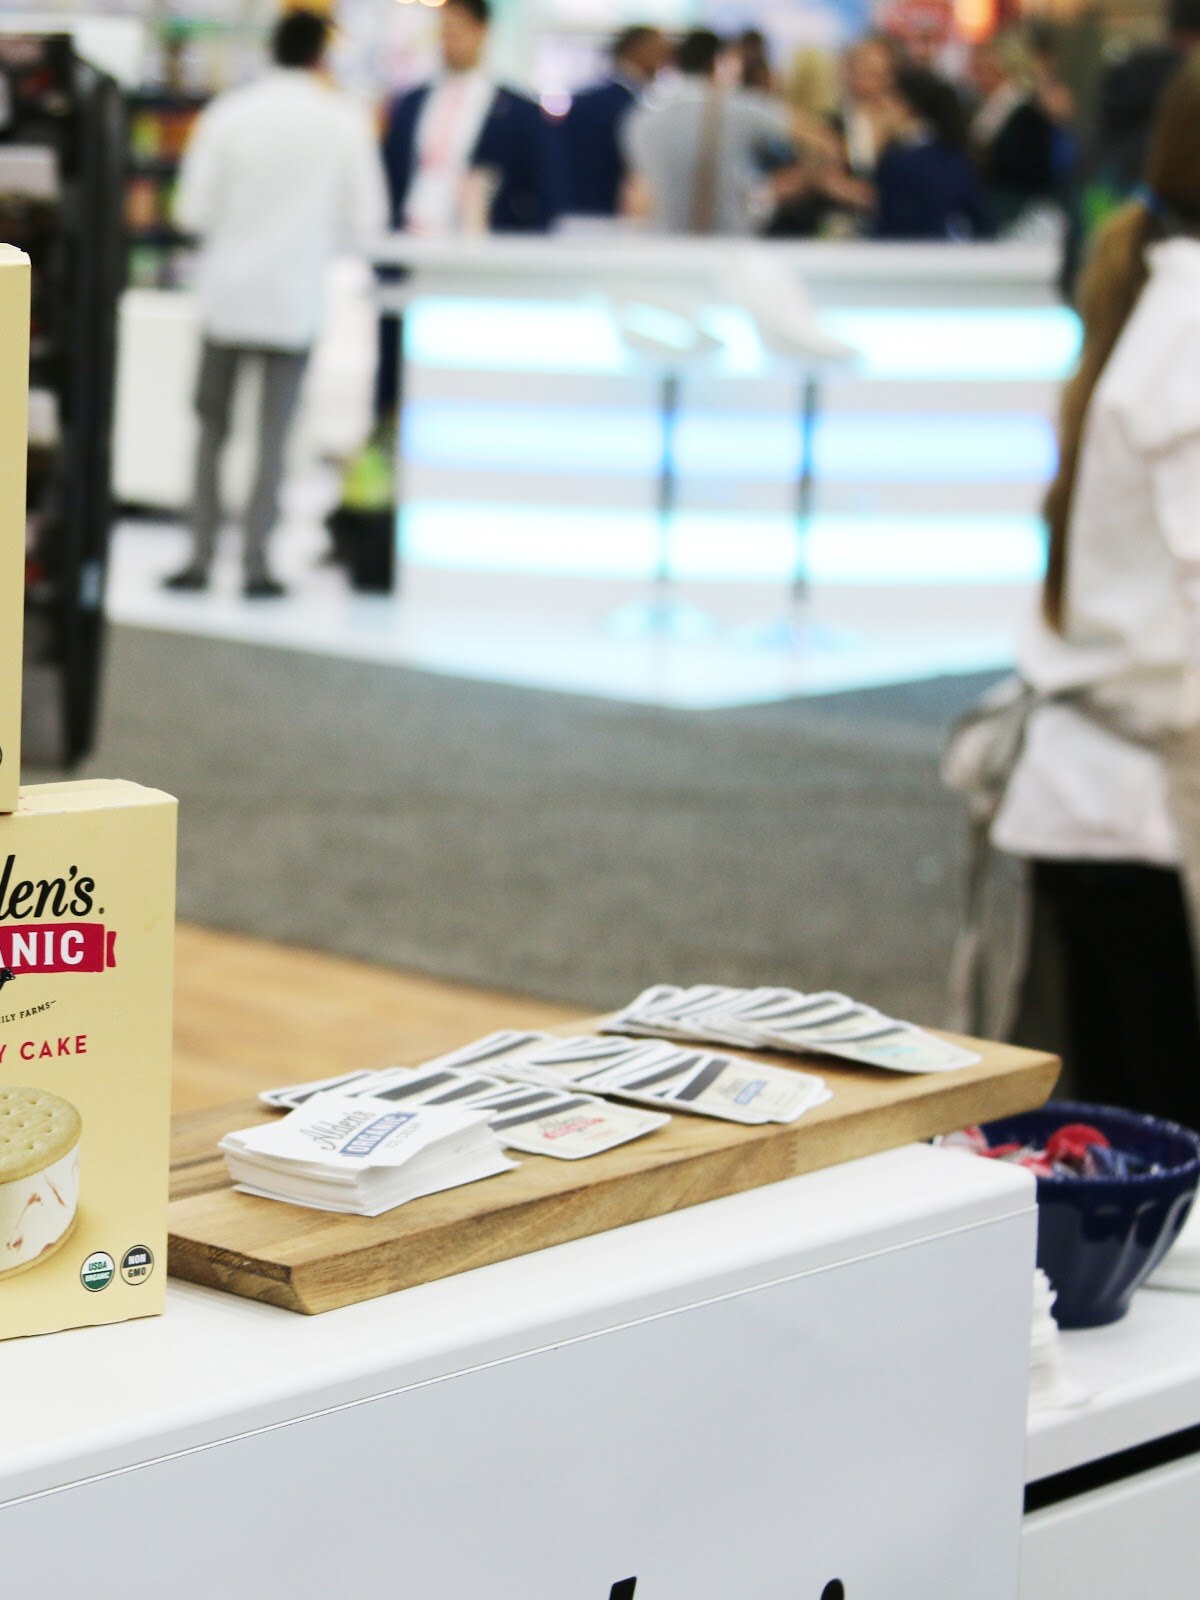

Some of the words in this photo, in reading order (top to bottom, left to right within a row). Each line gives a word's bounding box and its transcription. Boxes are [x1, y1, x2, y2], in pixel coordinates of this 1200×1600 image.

[20, 1035, 89, 1061] CAKE
[346, 1115, 408, 1152] ORGANIC
[128, 1253, 147, 1265] NON
[89, 1261, 107, 1272] USDA
[128, 1267, 146, 1278] GMO
